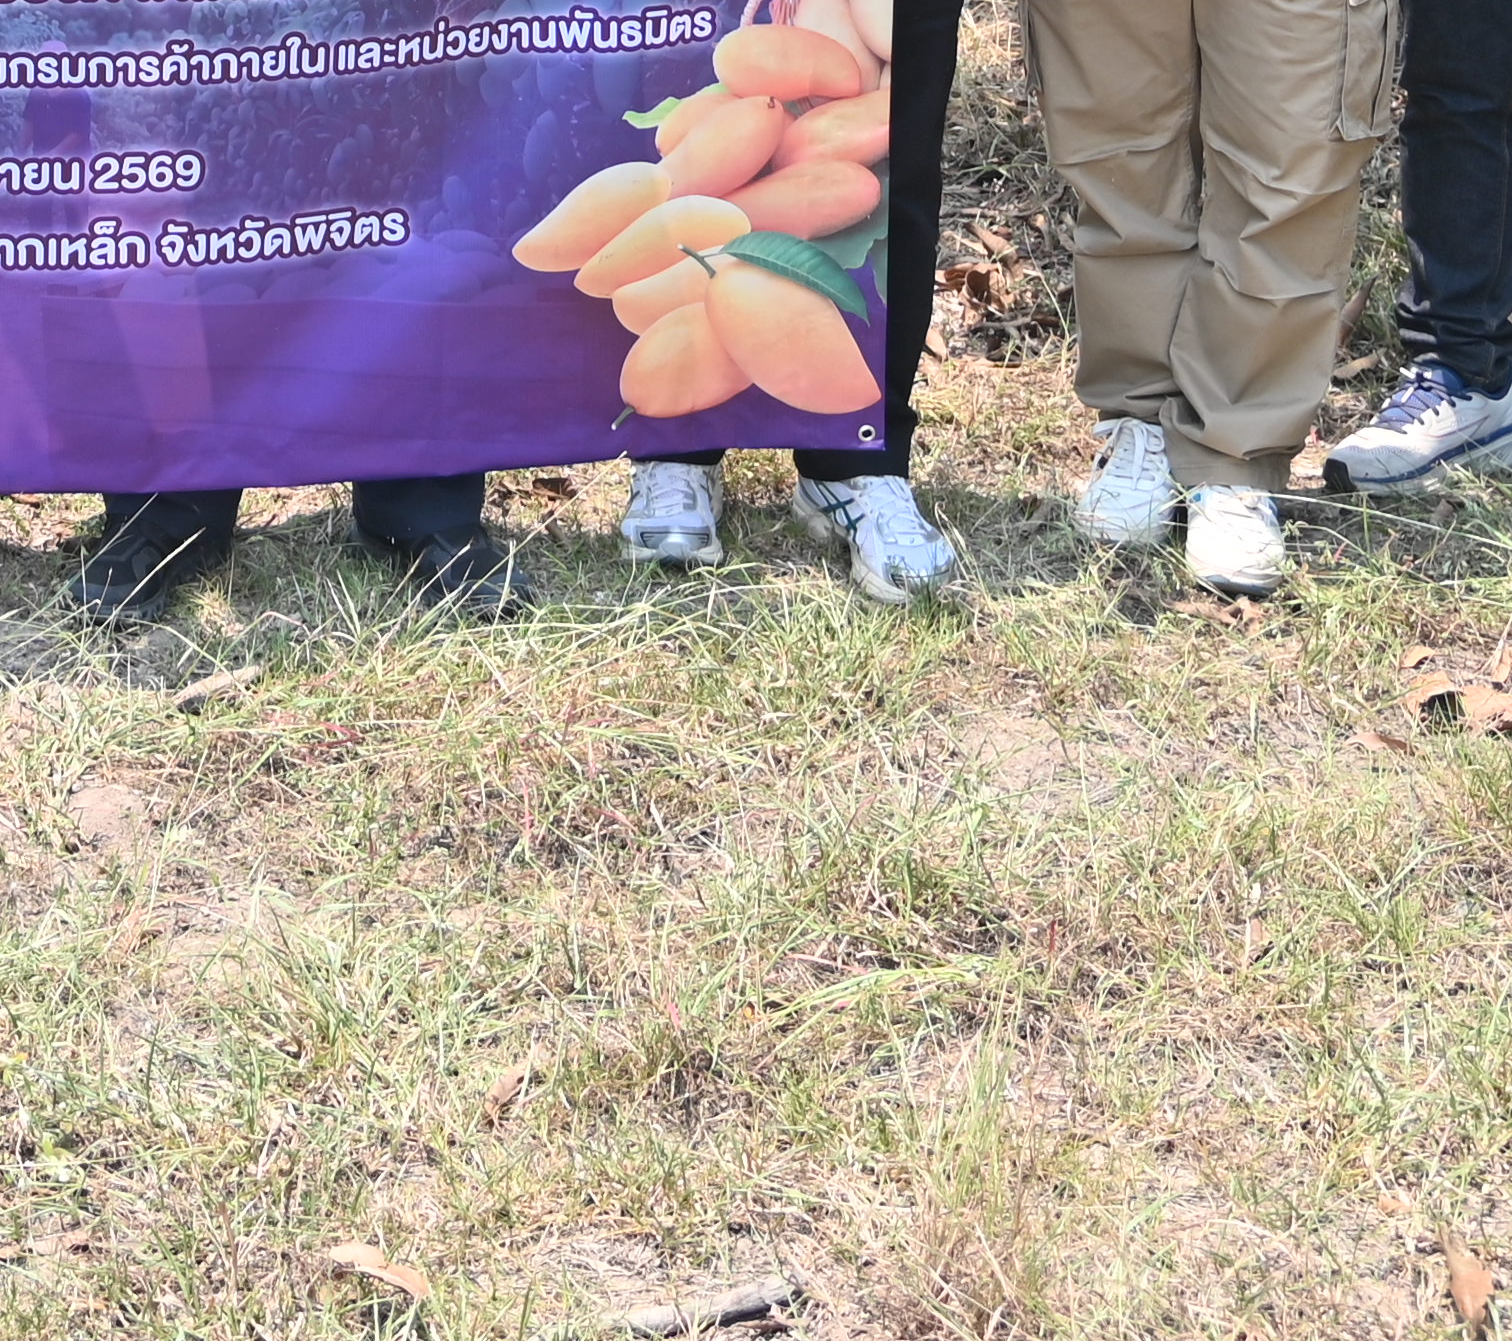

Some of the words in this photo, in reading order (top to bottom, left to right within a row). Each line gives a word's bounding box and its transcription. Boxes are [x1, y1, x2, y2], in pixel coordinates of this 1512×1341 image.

[337, 9, 713, 70] และหน่วยงานพันธมิตร
[92, 153, 202, 191] 2569
[160, 211, 406, 264] จังหวัดพิจิตร
